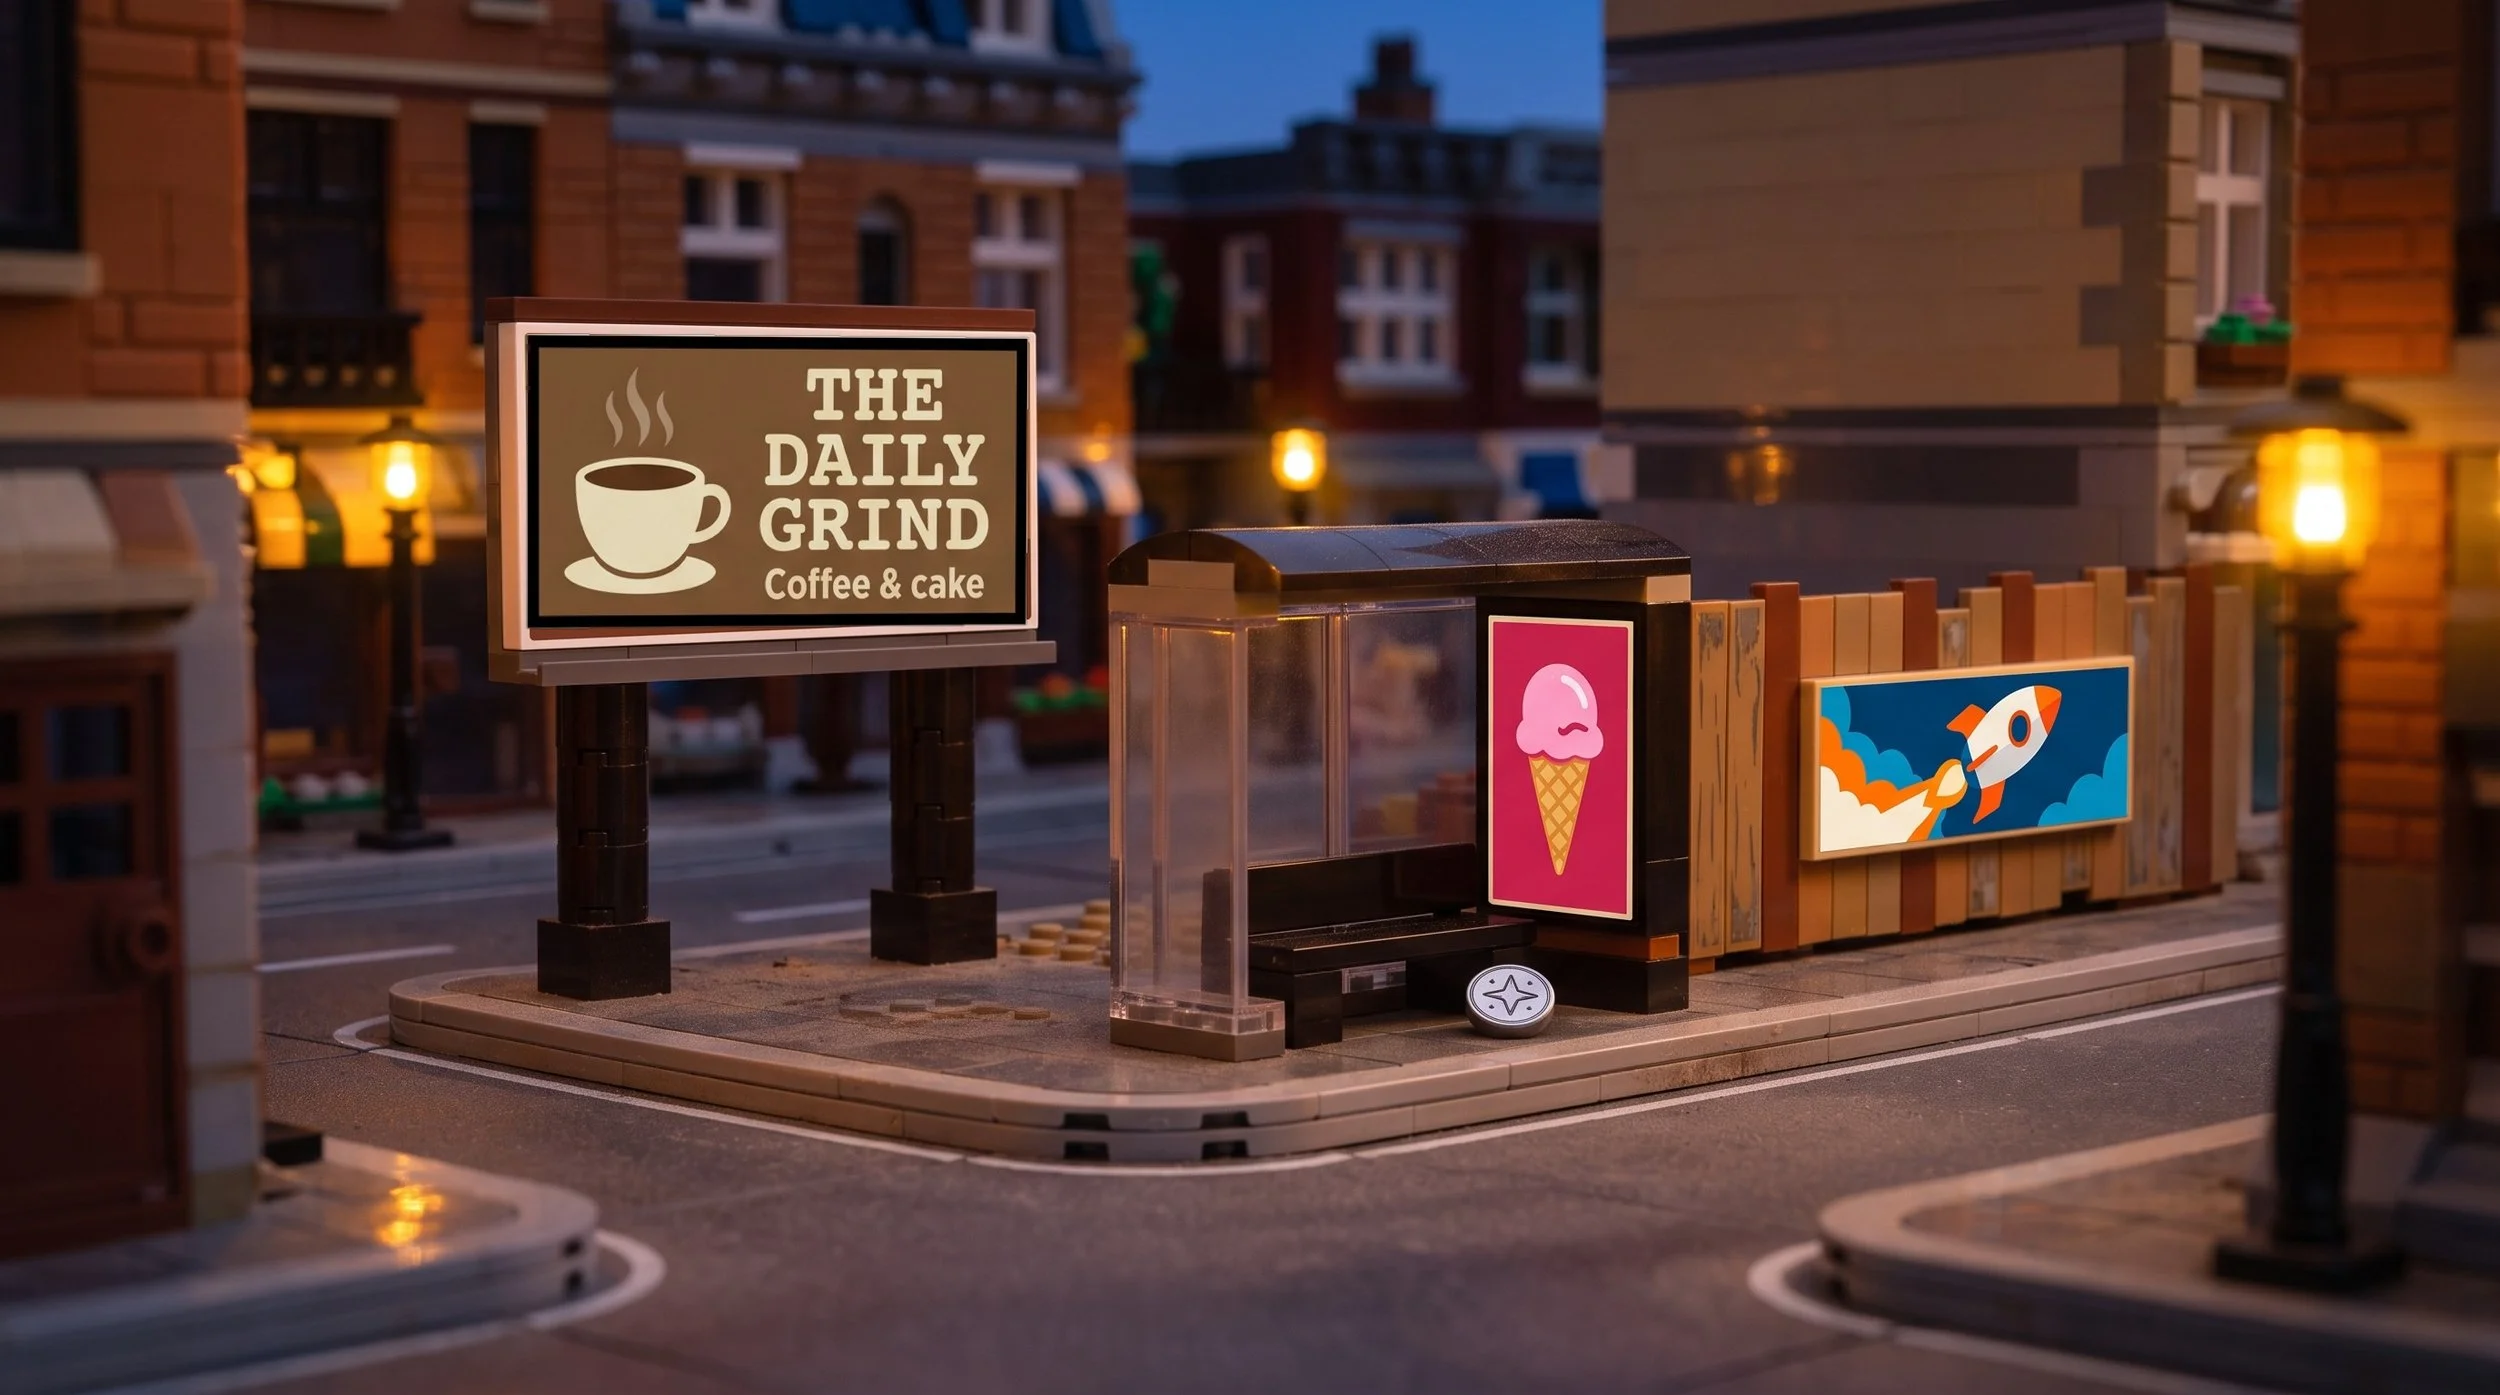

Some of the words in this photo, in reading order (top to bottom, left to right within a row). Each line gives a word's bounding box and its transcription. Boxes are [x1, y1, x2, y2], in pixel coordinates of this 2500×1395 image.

[807, 369, 943, 421] THE
[765, 434, 986, 486] DAILY
[759, 498, 989, 552] GRIND
[765, 567, 871, 600] Coffee
[879, 567, 902, 600] &
[911, 567, 984, 600] cake
